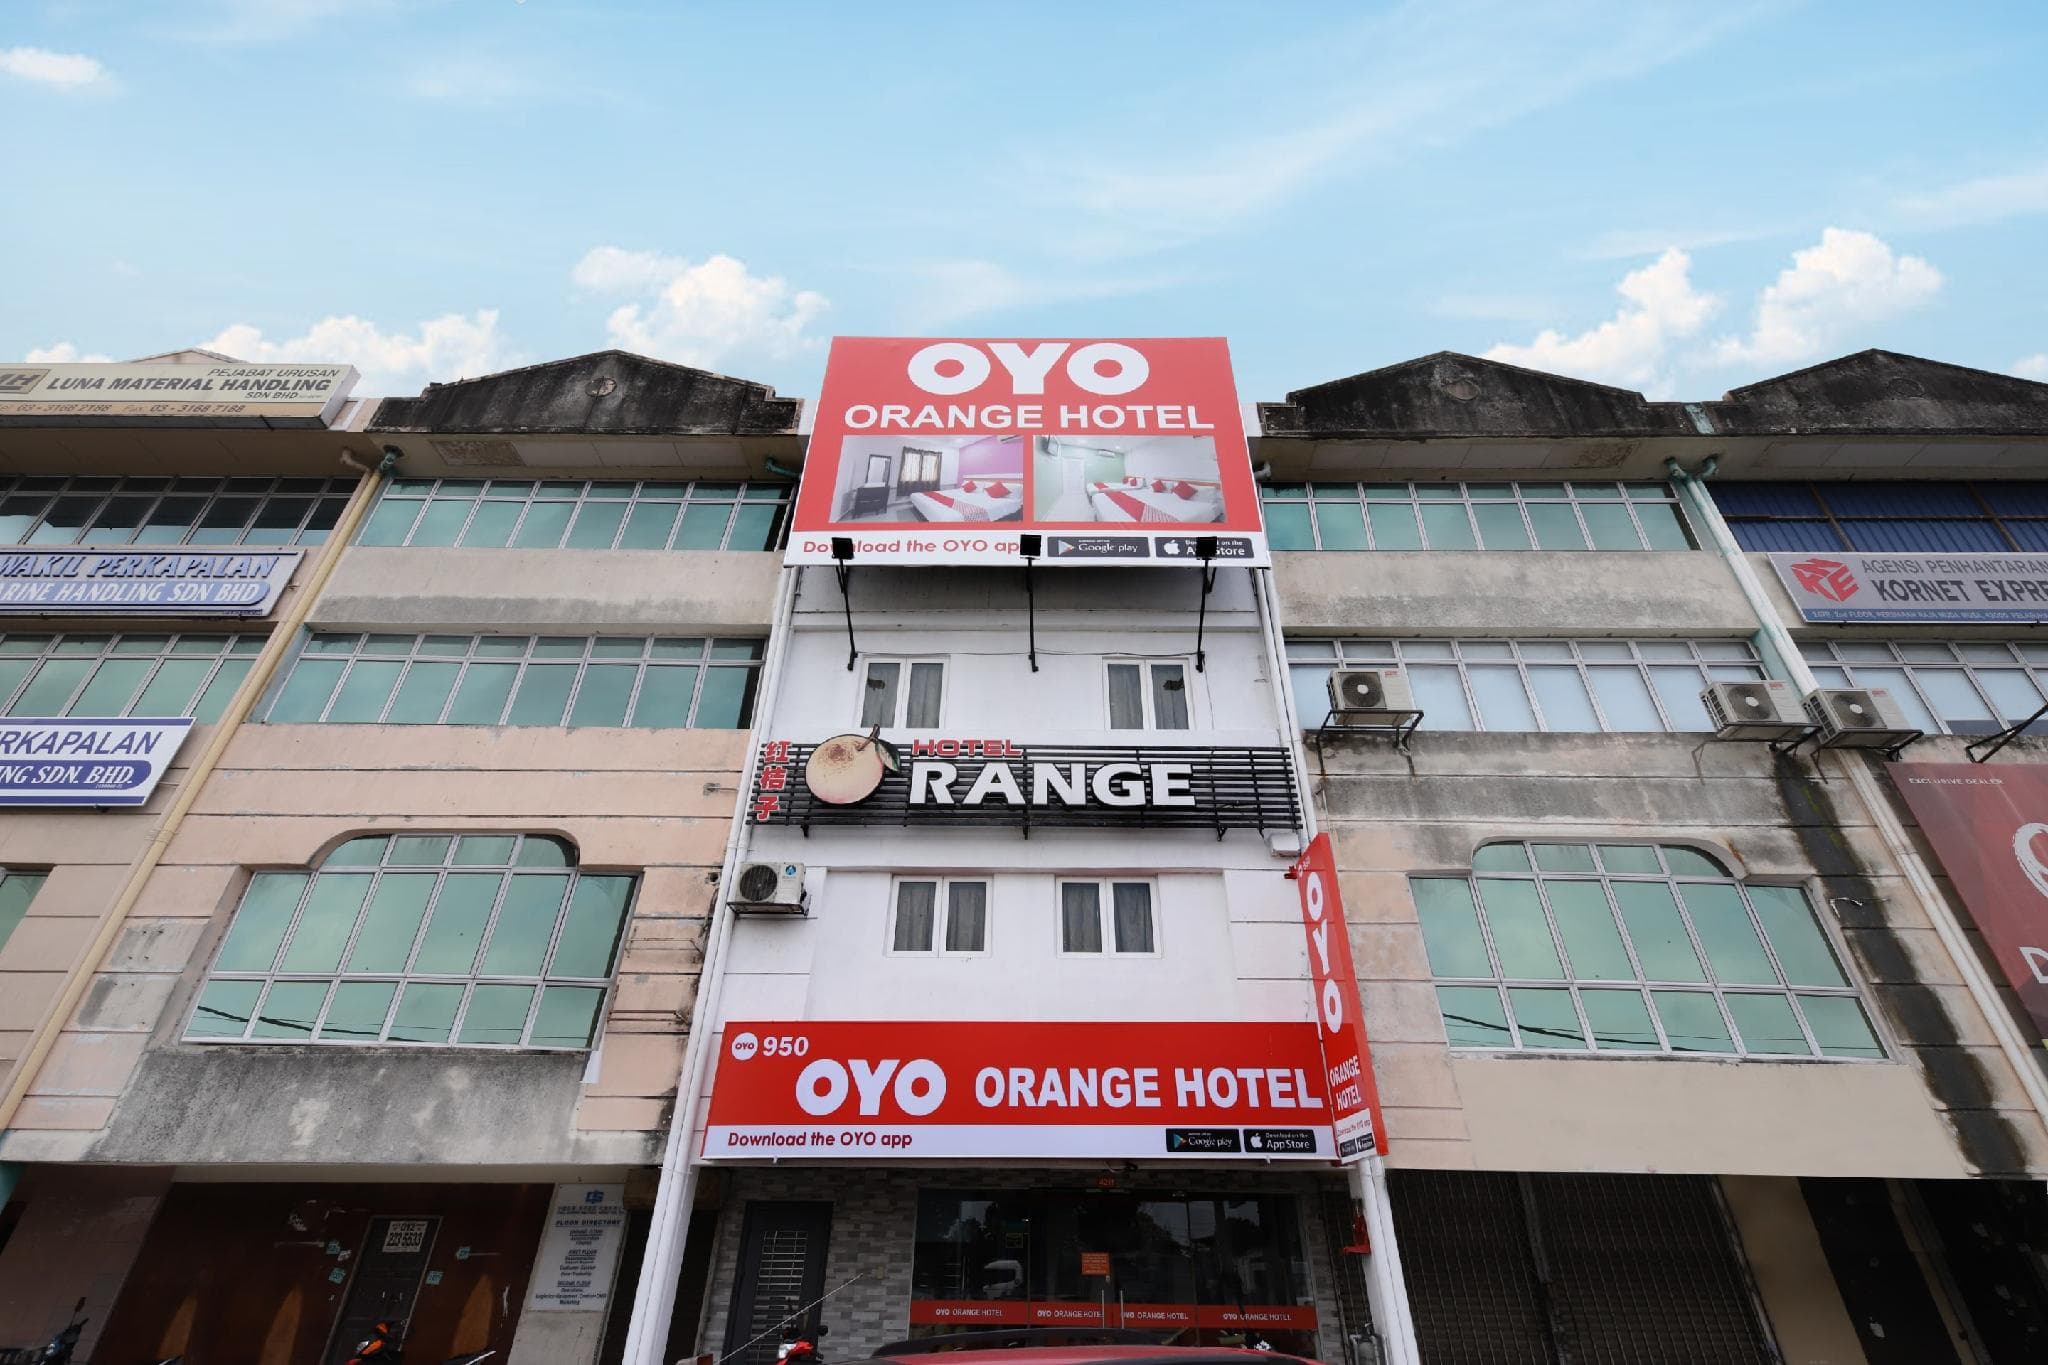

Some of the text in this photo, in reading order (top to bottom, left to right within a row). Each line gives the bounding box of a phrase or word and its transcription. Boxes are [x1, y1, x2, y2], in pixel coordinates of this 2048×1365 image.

[208, 368, 340, 377] PEJABAT URUSAN
[908, 343, 1150, 396] OYO
[47, 377, 332, 391] LUNA MATERIAL HANDLING
[245, 391, 271, 399] SDN
[271, 391, 299, 399] BHD
[844, 404, 1215, 429] ORANGE HOTEL
[906, 539, 937, 552] the
[943, 539, 988, 552] OYO
[1078, 543, 1138, 553] Google play
[87, 556, 280, 578] PERKAPALAN
[1862, 559, 1923, 574] AGENSI
[0, 582, 261, 602] RINE HANDLING SDN BHD
[1871, 579, 1971, 602] KORNET
[912, 739, 1023, 758] HOTEL
[31, 765, 83, 784] SDN.
[83, 765, 135, 784] BHD.
[753, 740, 792, 821] 红桔子
[909, 761, 1197, 808] RANGE
[735, 1036, 809, 1057] OYO 950
[1329, 1055, 1360, 1087] ORANGE
[796, 1058, 947, 1116] OYO
[975, 1067, 1324, 1109] ORANGE HOTEL
[1336, 1083, 1361, 1112] HOTEL
[727, 1131, 913, 1149] Download the OYO app
[1188, 1136, 1233, 1148] Google play
[1266, 1139, 1310, 1151] App Store
[935, 1308, 950, 1316] OYO
[981, 1309, 1003, 1317] HOTEL
[1037, 1309, 1052, 1317] OYO
[1054, 1309, 1083, 1318] ORANGE
[1137, 1311, 1166, 1319] ORANGE
[1166, 1312, 1189, 1320] HOTEL
